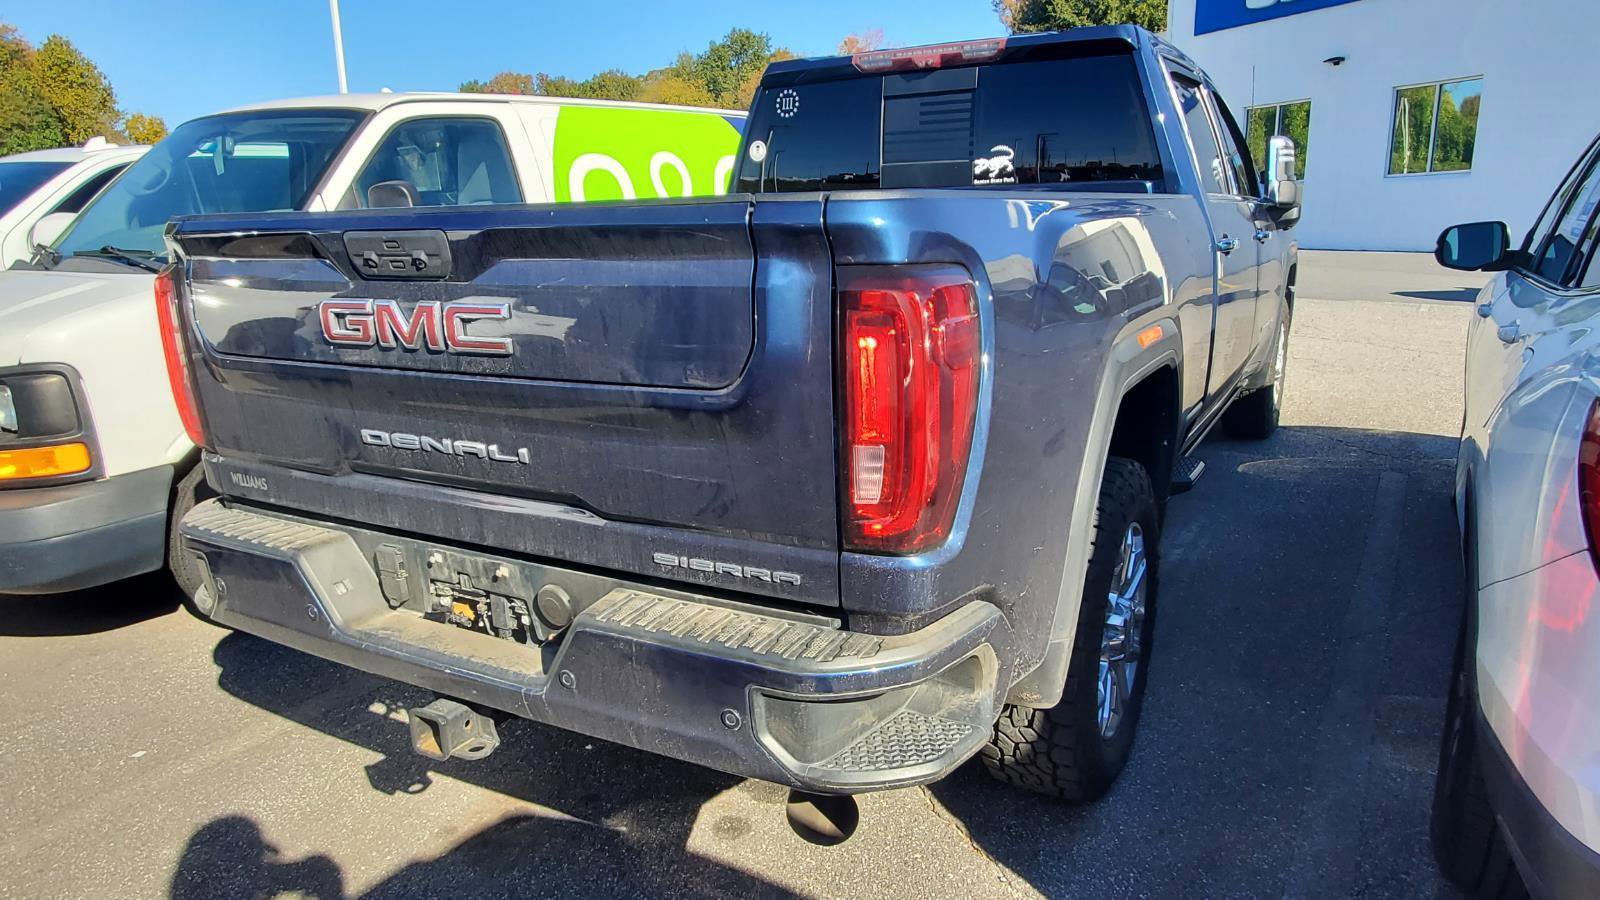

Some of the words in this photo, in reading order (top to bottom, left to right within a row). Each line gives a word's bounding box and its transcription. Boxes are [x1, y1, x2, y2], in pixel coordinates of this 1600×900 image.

[319, 298, 514, 355] GMC
[360, 428, 530, 464] DENALI
[230, 471, 268, 491] WILLIAMS
[653, 552, 801, 586] SIERRA
